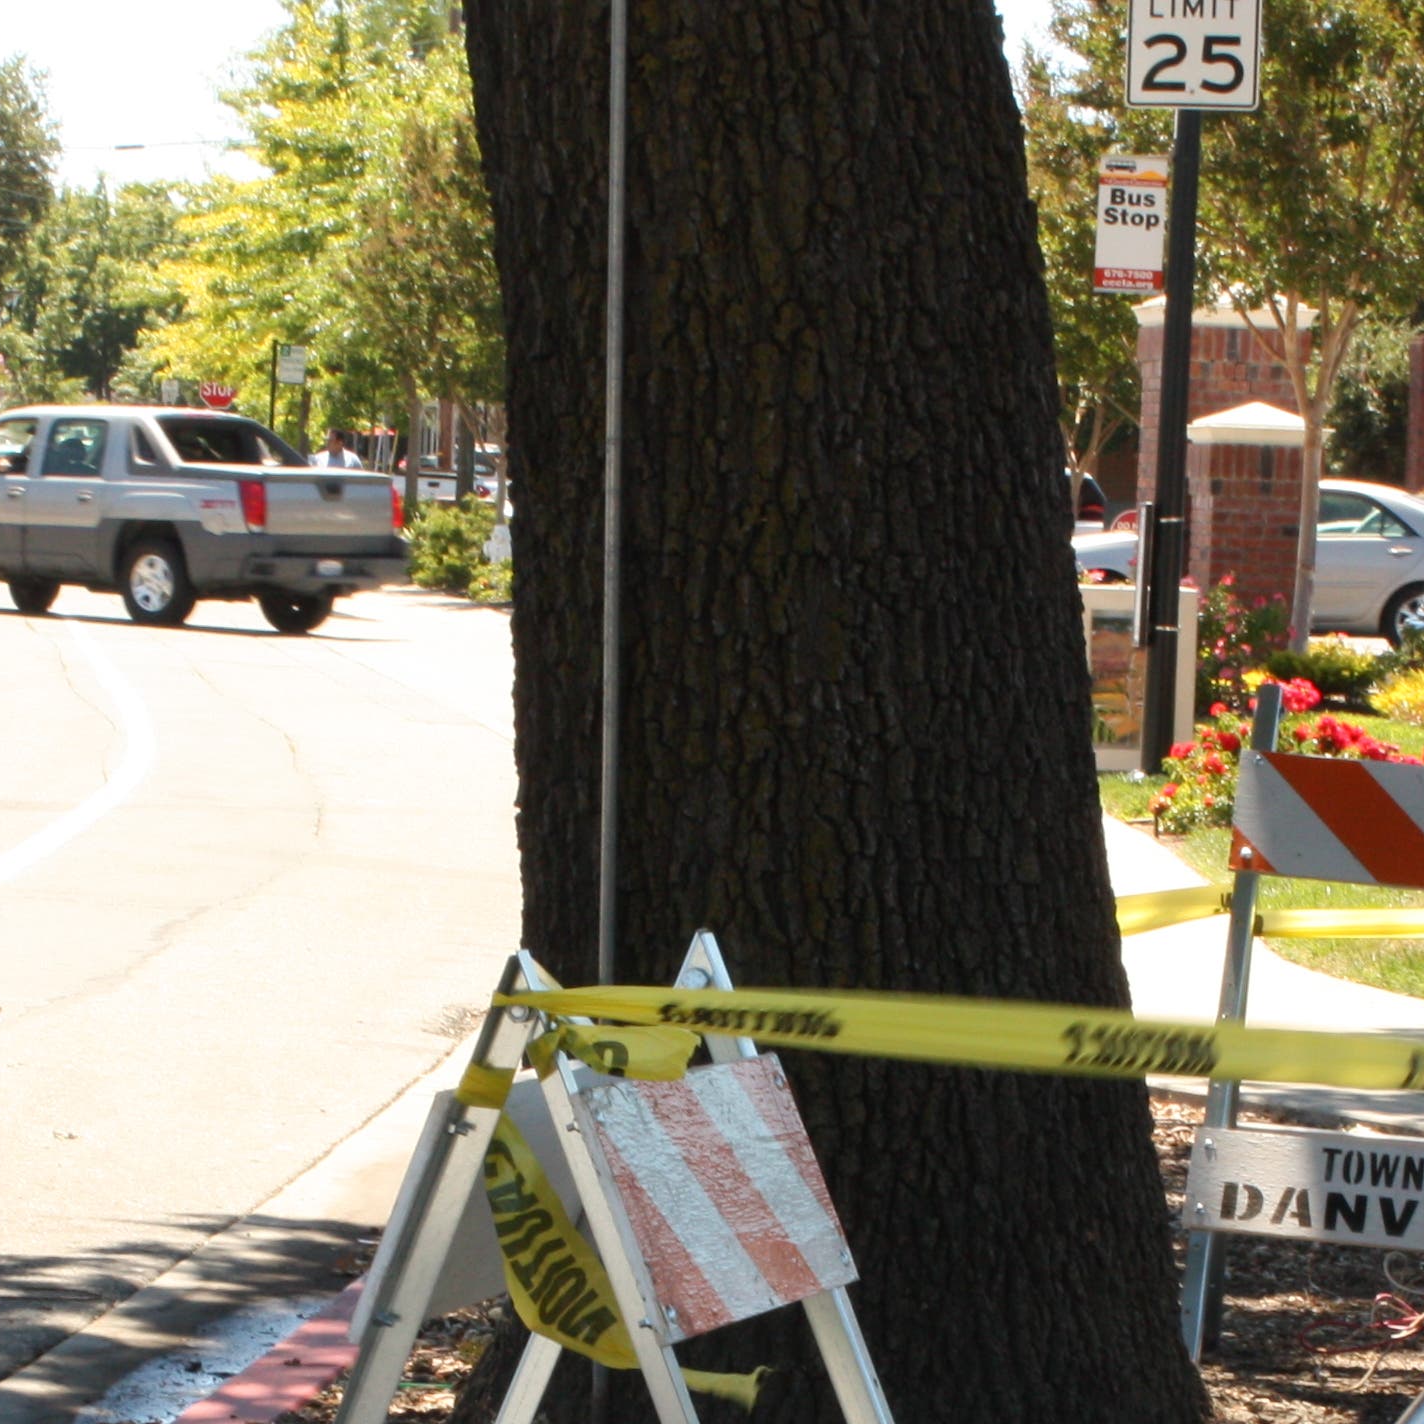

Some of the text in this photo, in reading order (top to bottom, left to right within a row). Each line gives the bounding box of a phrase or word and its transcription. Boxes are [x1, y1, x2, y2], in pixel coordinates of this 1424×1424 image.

[1149, 0, 1235, 19] LIMIT
[1141, 33, 1245, 94] 25
[1109, 187, 1156, 208] Bus
[1103, 206, 1160, 231] Stop
